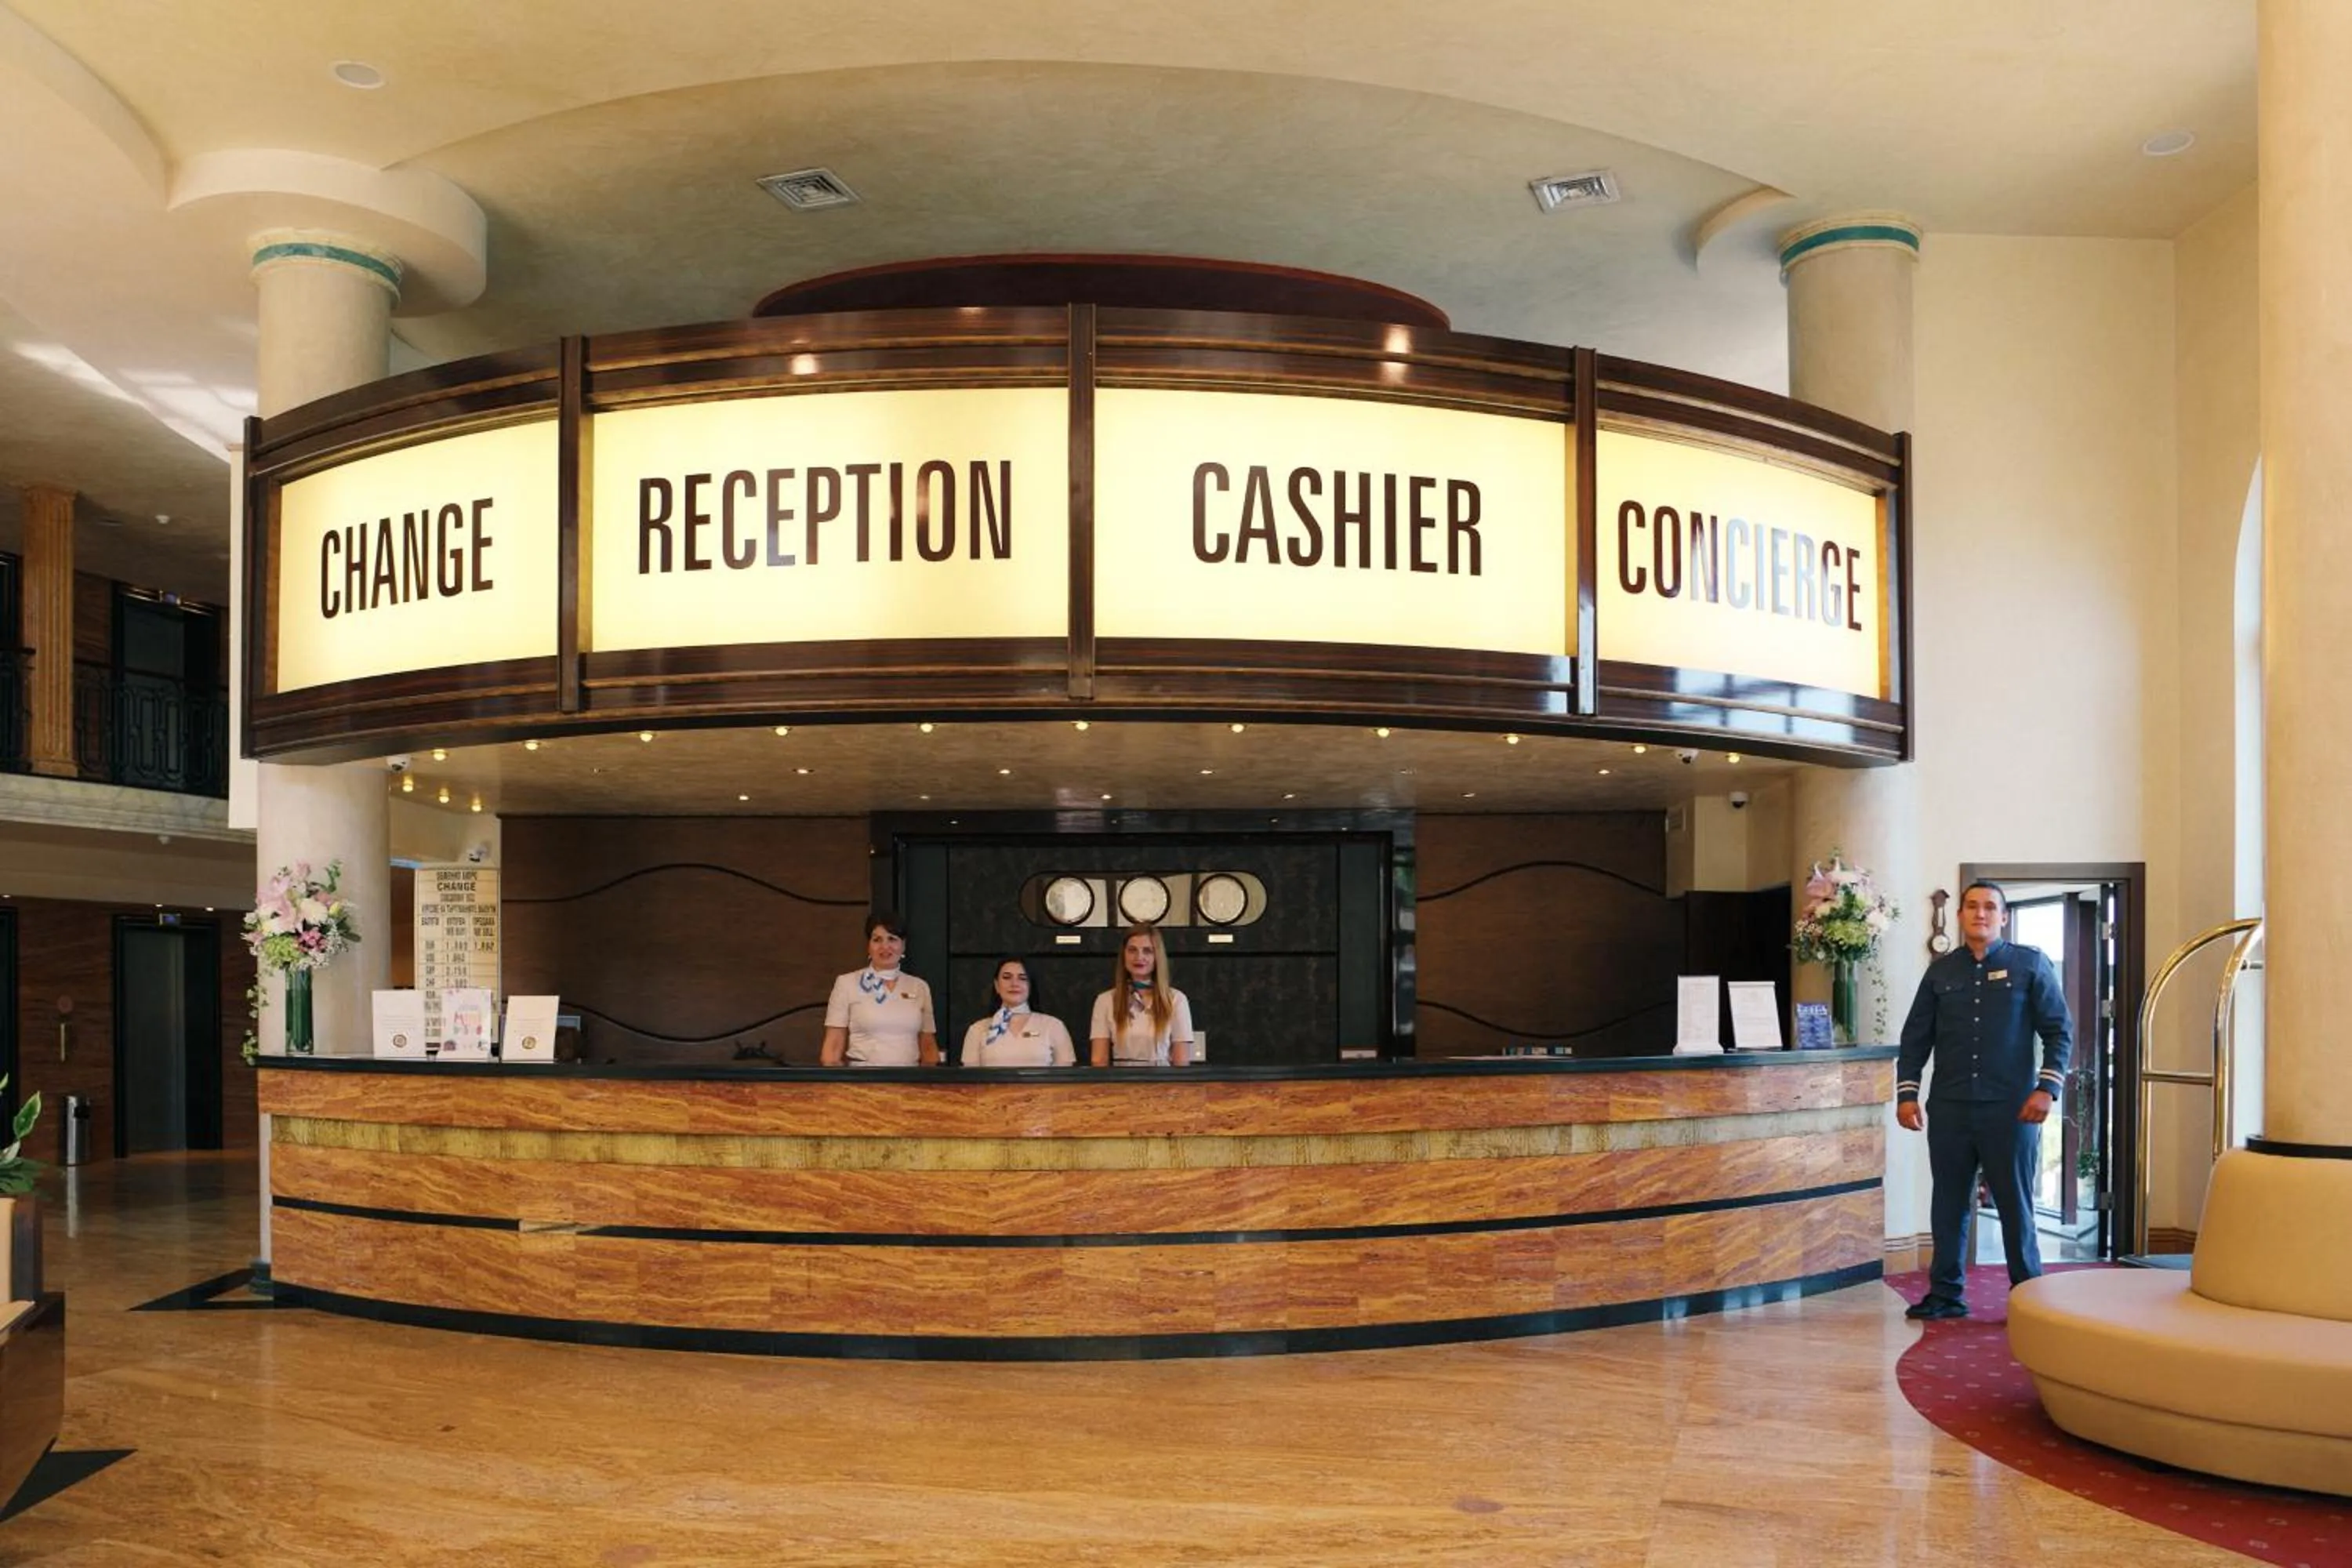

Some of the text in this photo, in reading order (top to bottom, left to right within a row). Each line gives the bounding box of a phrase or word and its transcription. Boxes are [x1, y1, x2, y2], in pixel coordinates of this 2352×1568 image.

[320, 497, 495, 619] CHANGE
[638, 459, 1012, 575] RECEPTION
[1192, 461, 1483, 576] CASHIER
[1617, 499, 1863, 632] CONCIERGE
[437, 882, 477, 891] CHANGE
